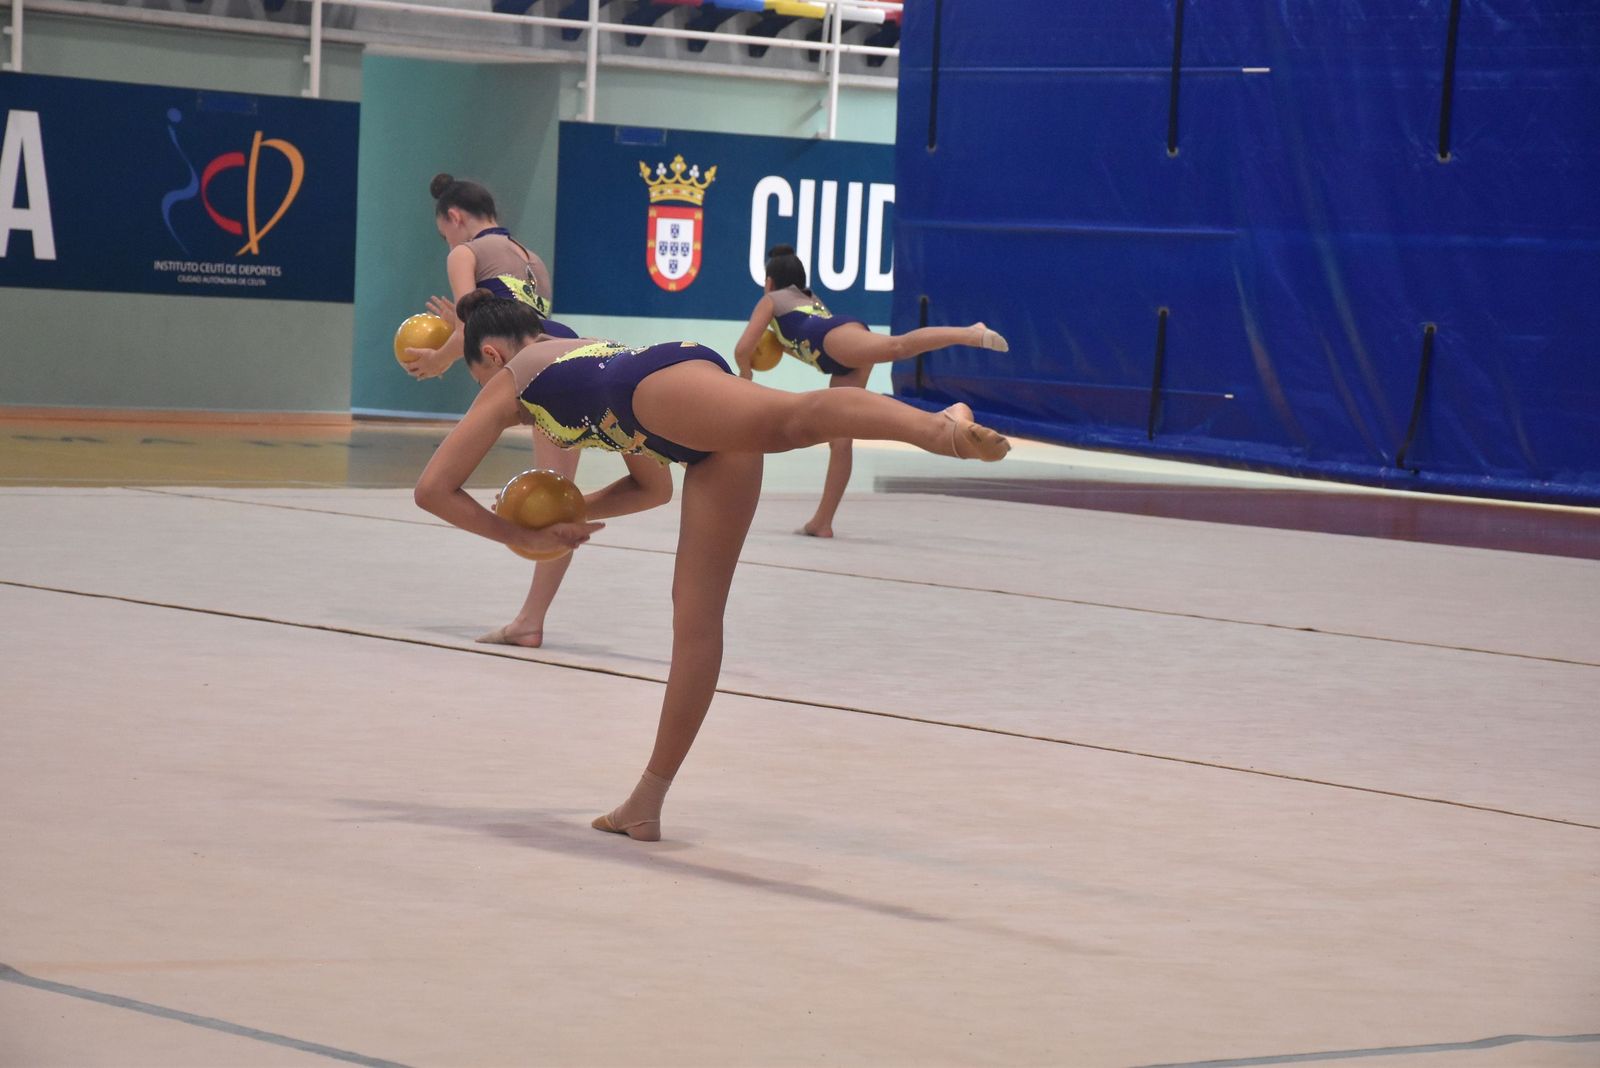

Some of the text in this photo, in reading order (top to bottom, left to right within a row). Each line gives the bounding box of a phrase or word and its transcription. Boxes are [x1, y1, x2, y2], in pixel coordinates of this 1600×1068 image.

[0, 109, 57, 260] A
[154, 261, 198, 272] INSTITUTO
[225, 264, 237, 275] DE
[239, 265, 282, 277] DEPORTES
[177, 275, 201, 283] CIUDAD
